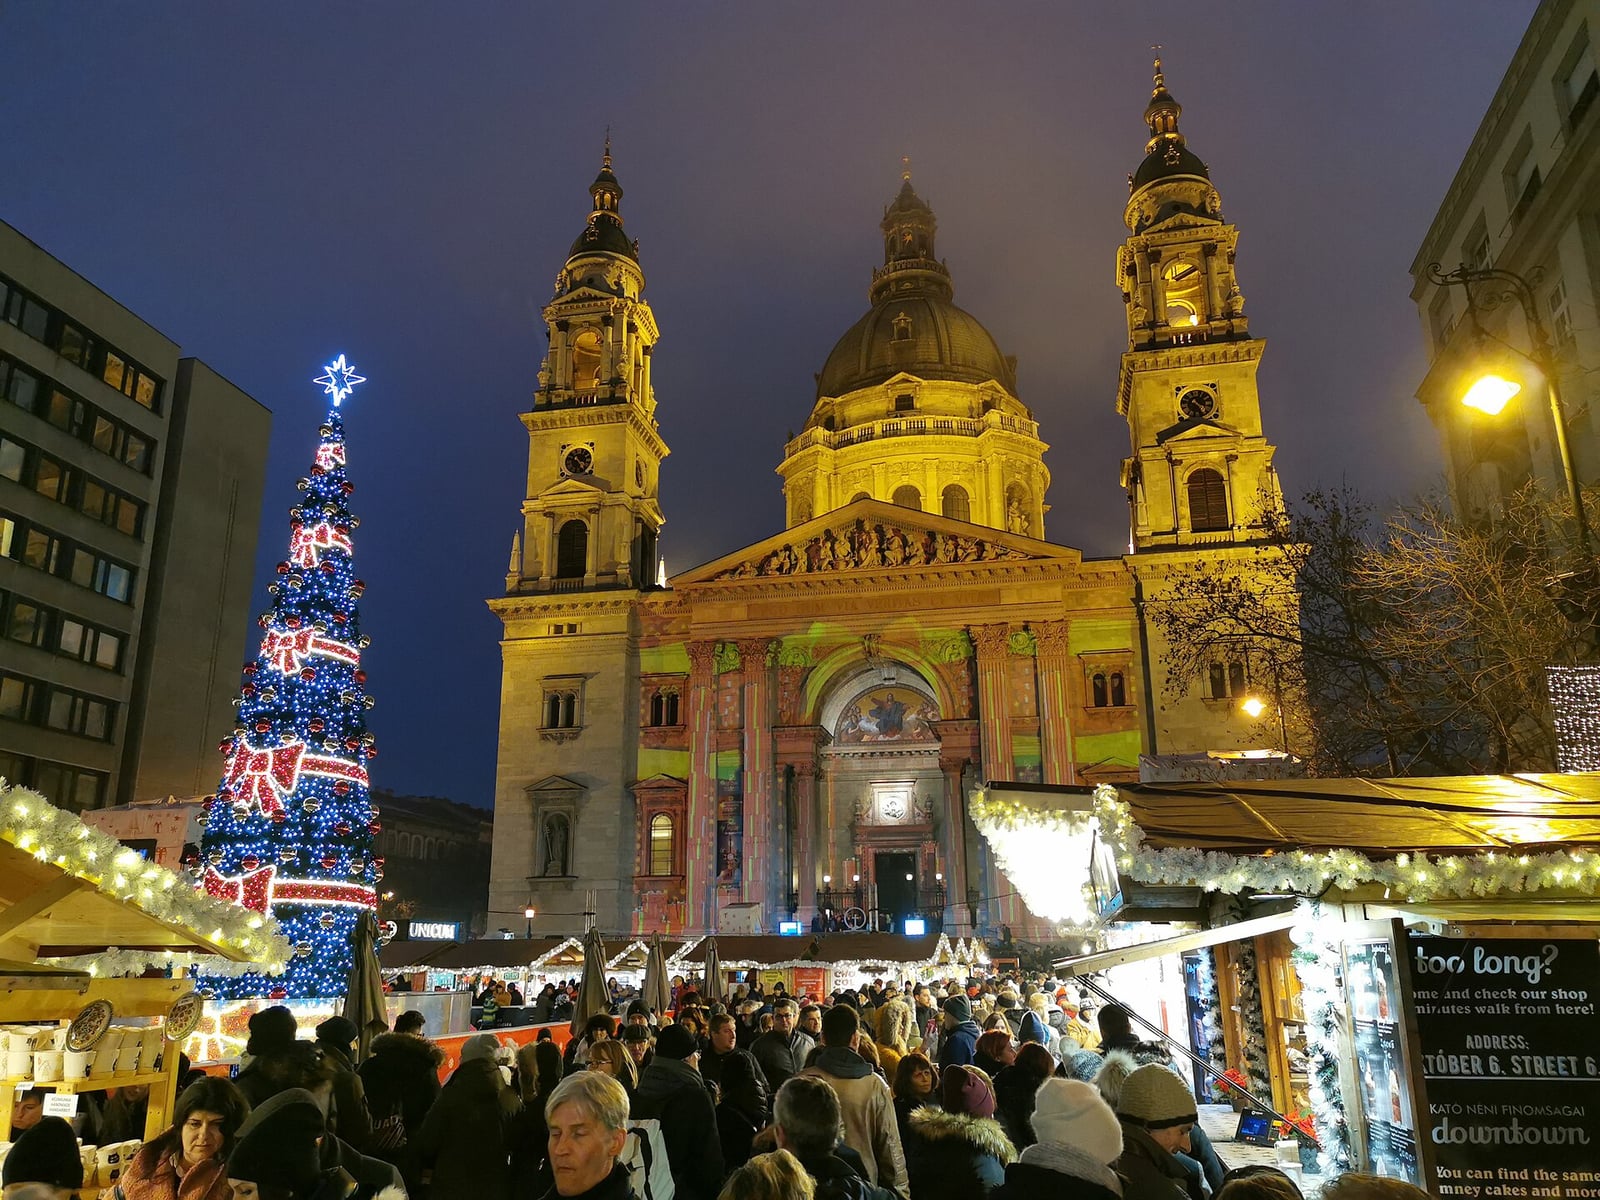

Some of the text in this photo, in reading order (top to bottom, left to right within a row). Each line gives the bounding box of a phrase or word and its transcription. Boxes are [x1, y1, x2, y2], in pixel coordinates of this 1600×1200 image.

[1414, 946, 1465, 974] too
[1473, 944, 1559, 985] long?
[1474, 987, 1517, 1000] check
[1521, 990, 1547, 1000] our
[1551, 988, 1588, 1001] shop
[1475, 1003, 1511, 1015] walk
[1515, 1003, 1551, 1015] from
[1556, 1003, 1595, 1015] here!
[1466, 1035, 1530, 1050] ADDRESS:
[1488, 1055, 1506, 1075] 6.
[1510, 1055, 1578, 1076] STREET
[1431, 1117, 1591, 1145] downtown
[1436, 1166, 1462, 1179] You
[1466, 1170, 1493, 1180] can
[1498, 1168, 1529, 1181] find
[1534, 1169, 1559, 1181] the
[1485, 1185, 1527, 1197] cakes
[1531, 1186, 1561, 1198] and
